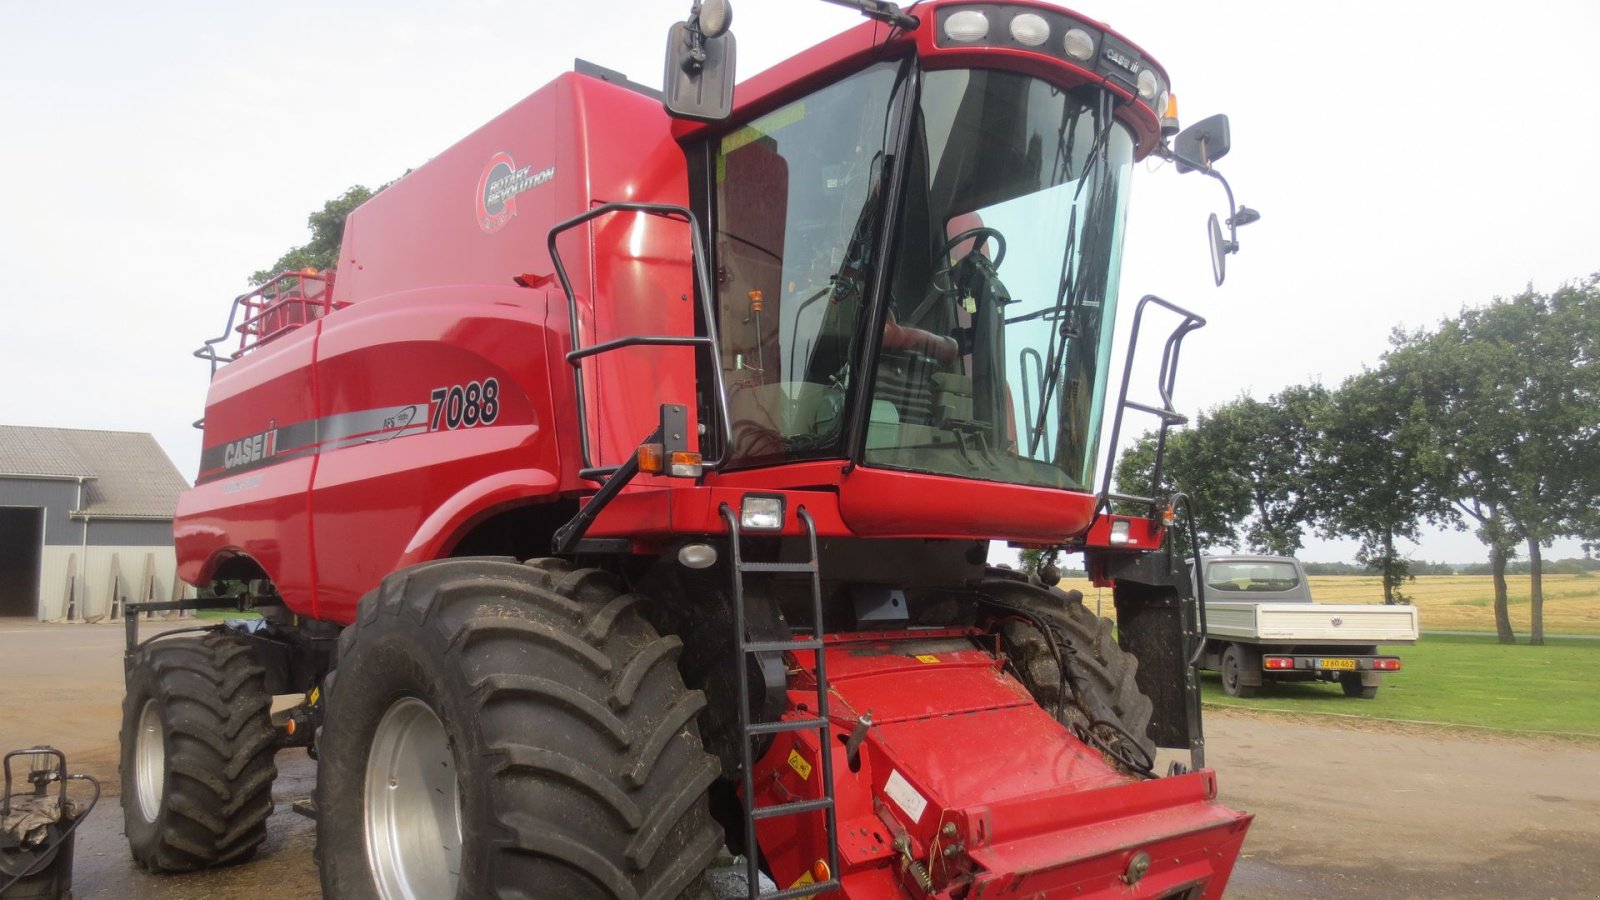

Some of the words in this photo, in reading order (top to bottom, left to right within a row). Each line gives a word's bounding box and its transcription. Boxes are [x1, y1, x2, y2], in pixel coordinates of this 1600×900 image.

[1106, 48, 1130, 69] CASE
[487, 166, 556, 207] REVOLUTION
[489, 164, 532, 195] ROTARY
[429, 377, 500, 433] 7088
[383, 416, 395, 429] AFS
[224, 434, 263, 469] CASE
